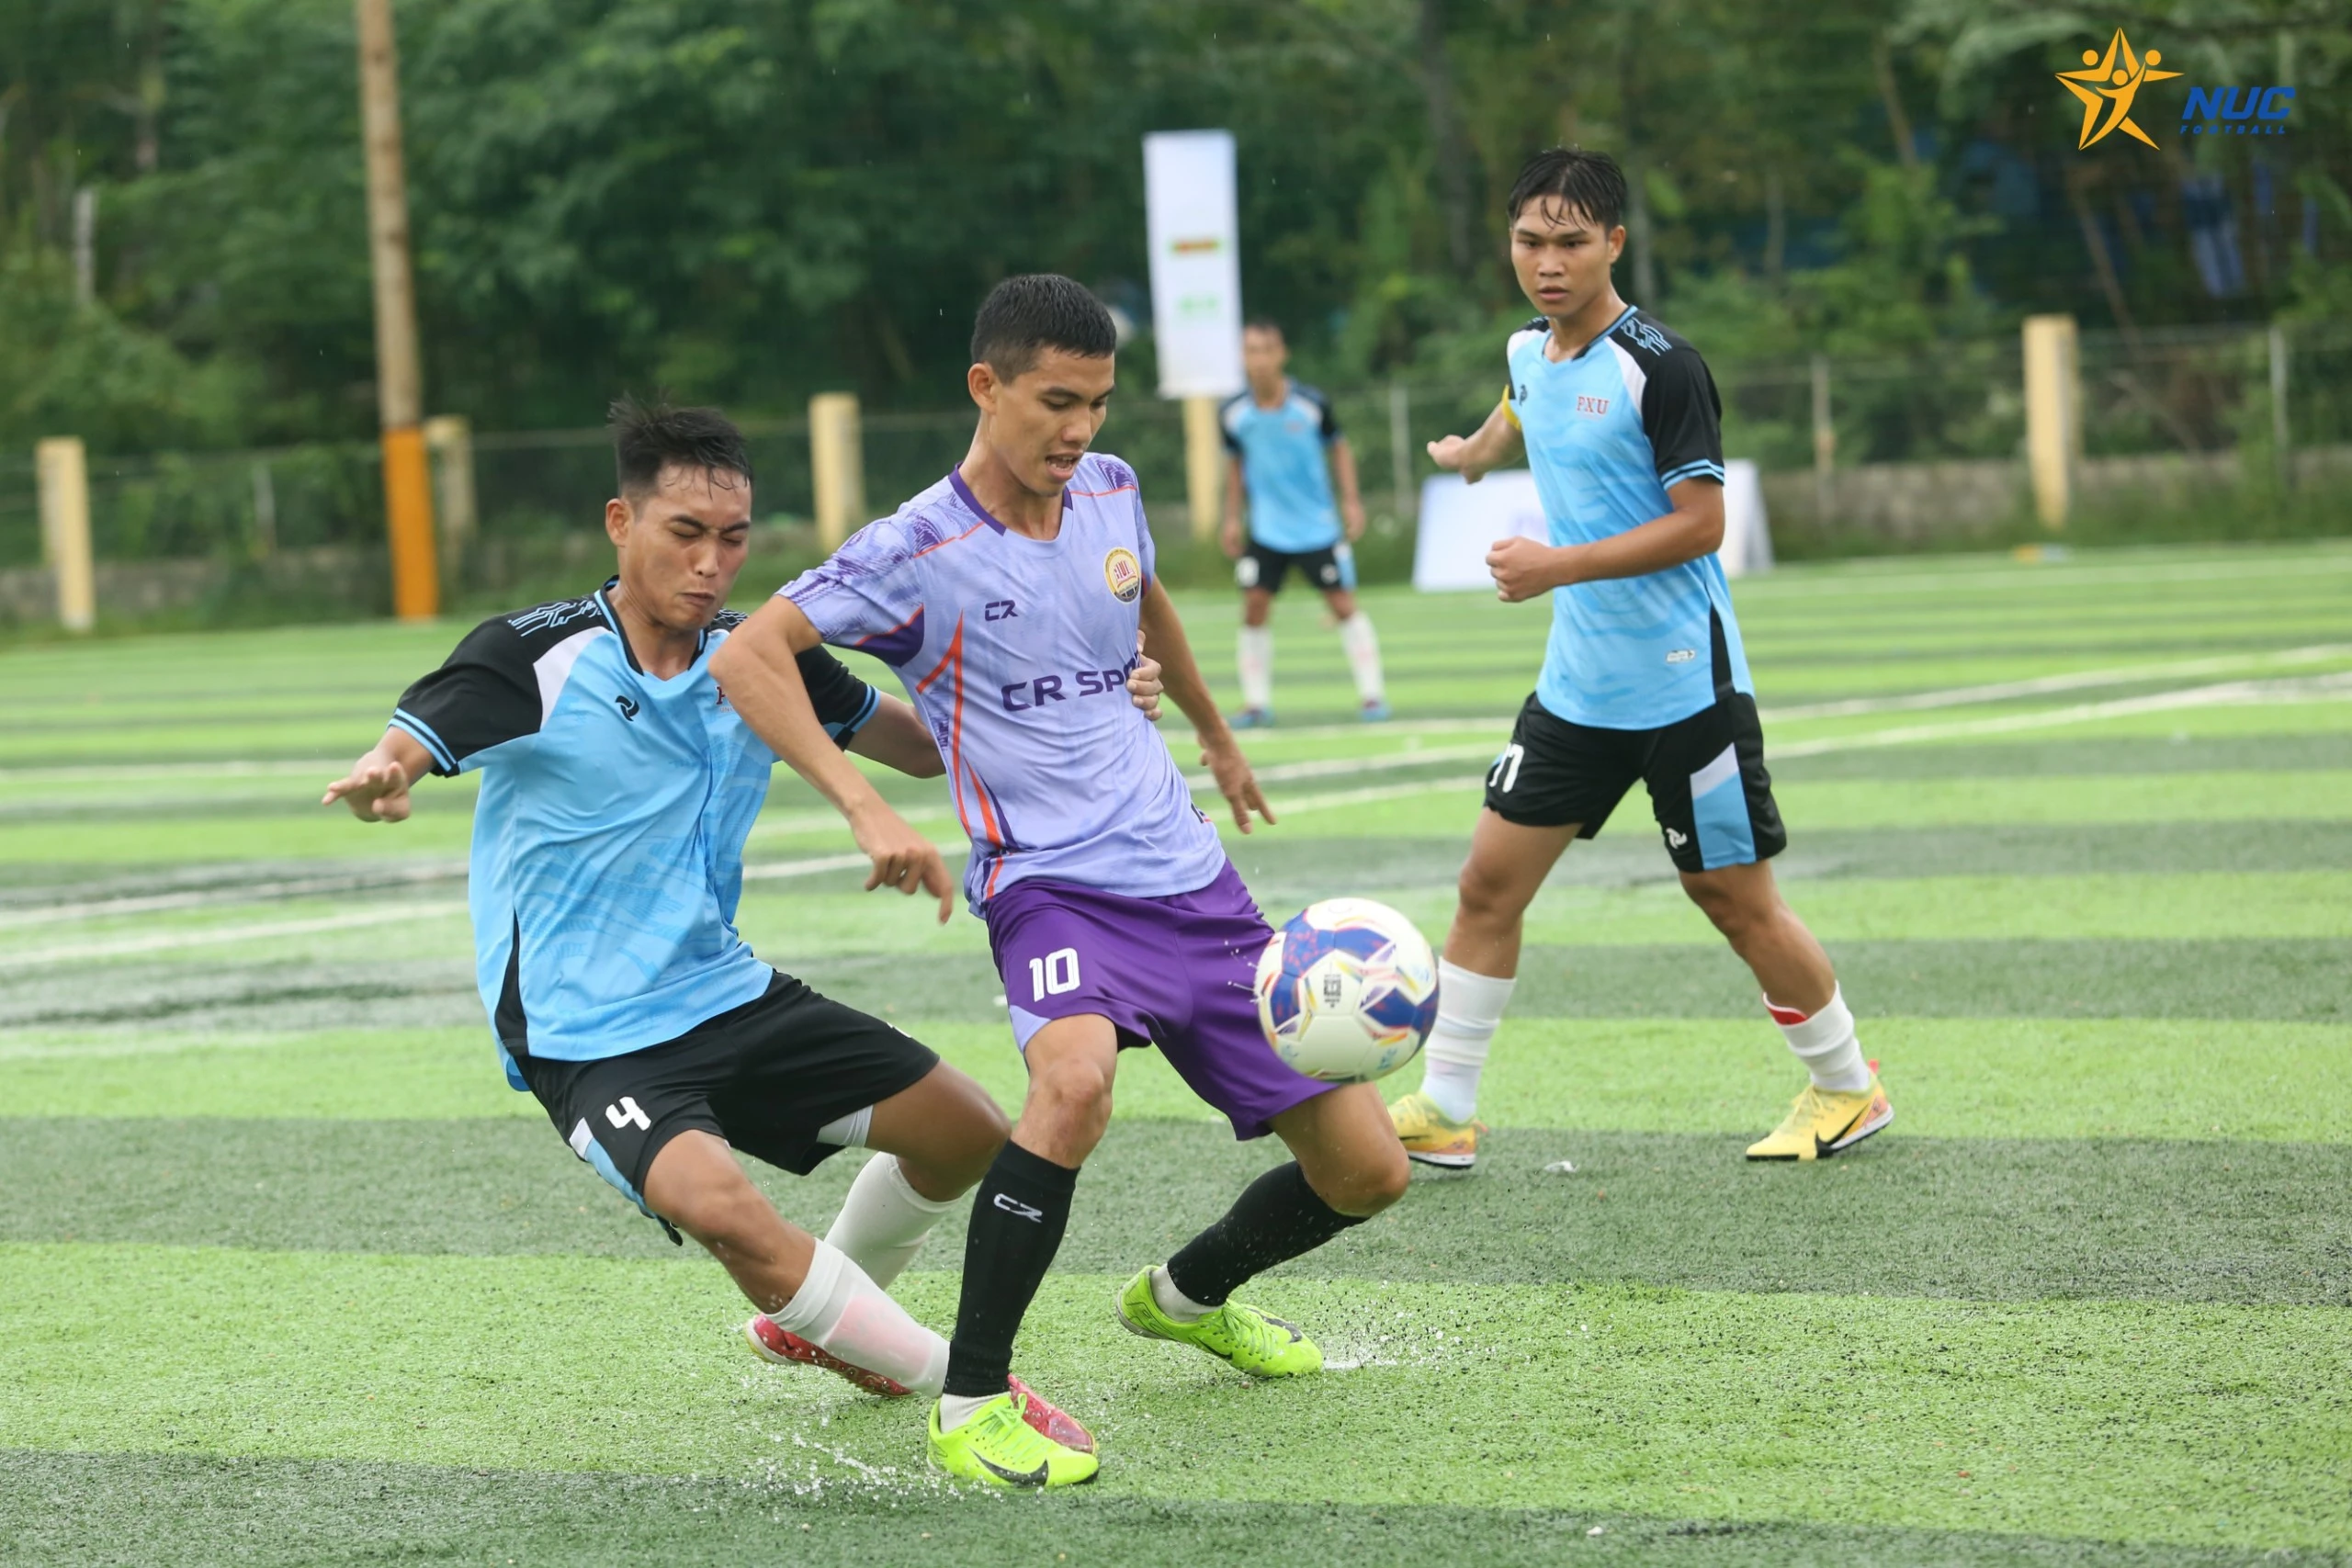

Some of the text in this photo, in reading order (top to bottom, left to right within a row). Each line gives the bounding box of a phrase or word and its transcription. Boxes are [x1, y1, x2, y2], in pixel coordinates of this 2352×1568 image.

[1577, 396, 1610, 415] PXU
[1001, 649, 1138, 712] CR SPO
[1029, 947, 1080, 1002] 10
[605, 1096, 651, 1131] 4
